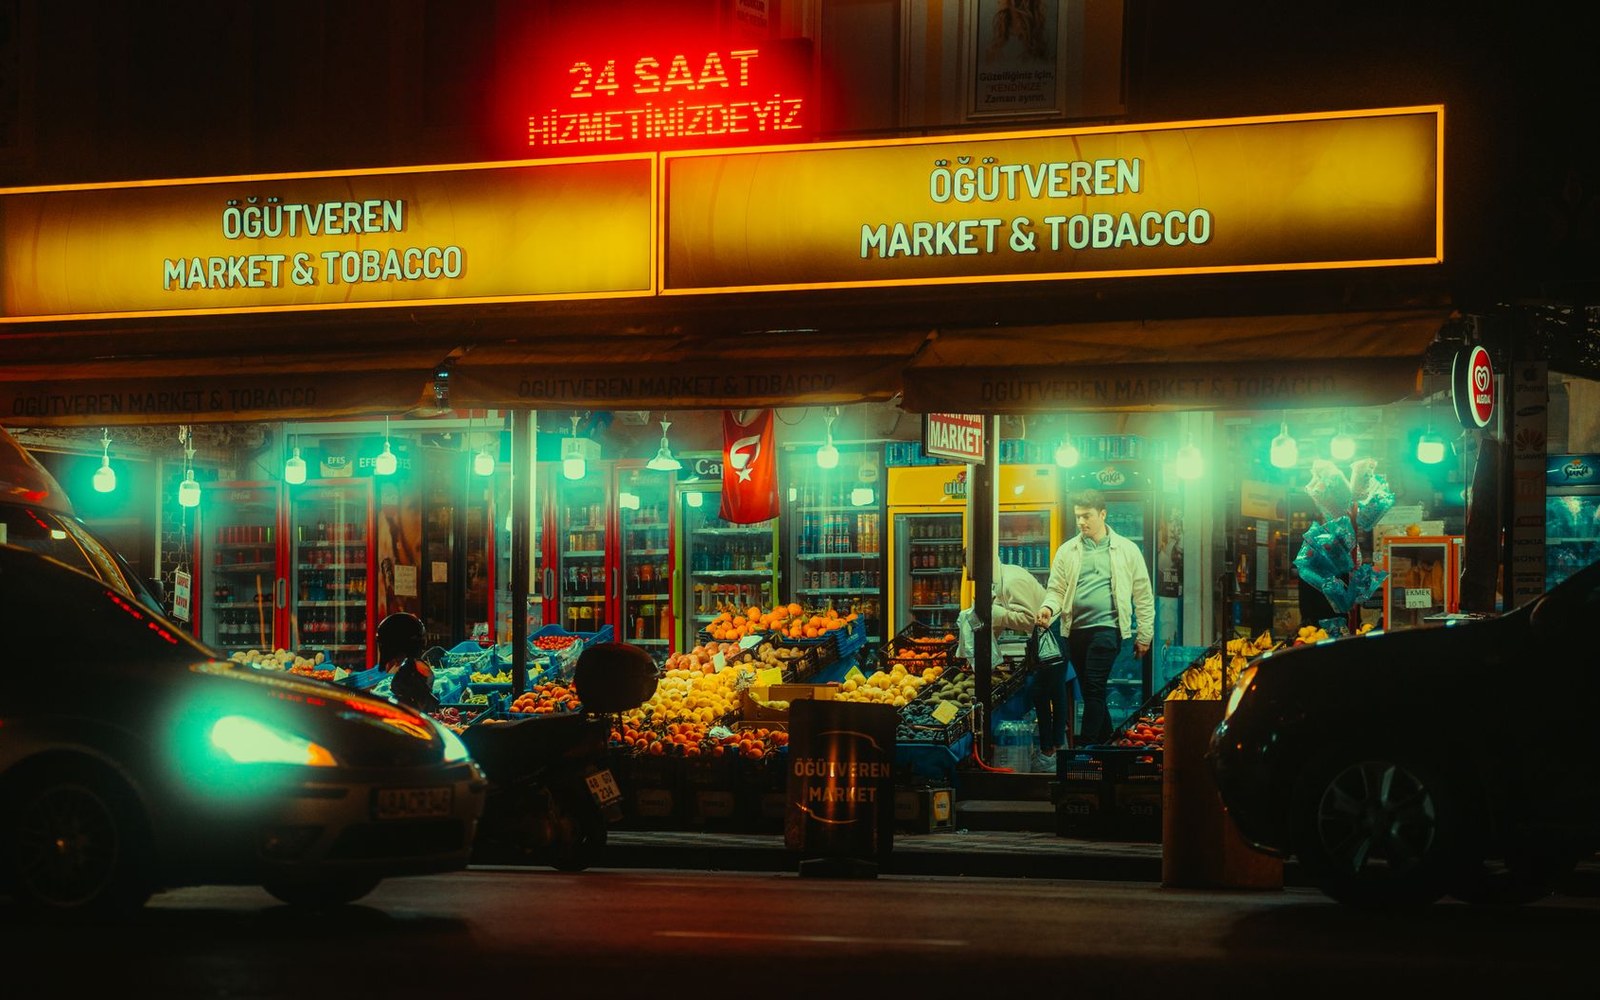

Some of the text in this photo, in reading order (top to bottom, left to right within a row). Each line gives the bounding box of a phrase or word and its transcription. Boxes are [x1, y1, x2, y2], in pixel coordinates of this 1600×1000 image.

[569, 49, 759, 98] 24 SAAT
[528, 93, 803, 145] HİZMETİNİZDEYİZ
[929, 156, 1141, 203] ÖĞÜTVEREN
[222, 196, 403, 240] ÖĞÜTVEREN
[860, 208, 1212, 258] MARKET & TOBACCO
[163, 245, 464, 290] MARKET & TOBACCO
[128, 390, 204, 412] MARKET
[210, 390, 223, 410] &
[228, 387, 317, 409] TOBACCO
[639, 375, 719, 396] MARKET
[723, 375, 738, 395] &
[744, 374, 836, 395] TOBACCO
[1114, 377, 1204, 399] MARKET
[1233, 375, 1337, 397] TOBACCO
[930, 420, 982, 454] MARKET
[327, 456, 346, 465] EFES
[359, 457, 377, 468] EFE
[794, 757, 890, 778] ÖĞÜTVEREN
[808, 786, 877, 802] MARKET
